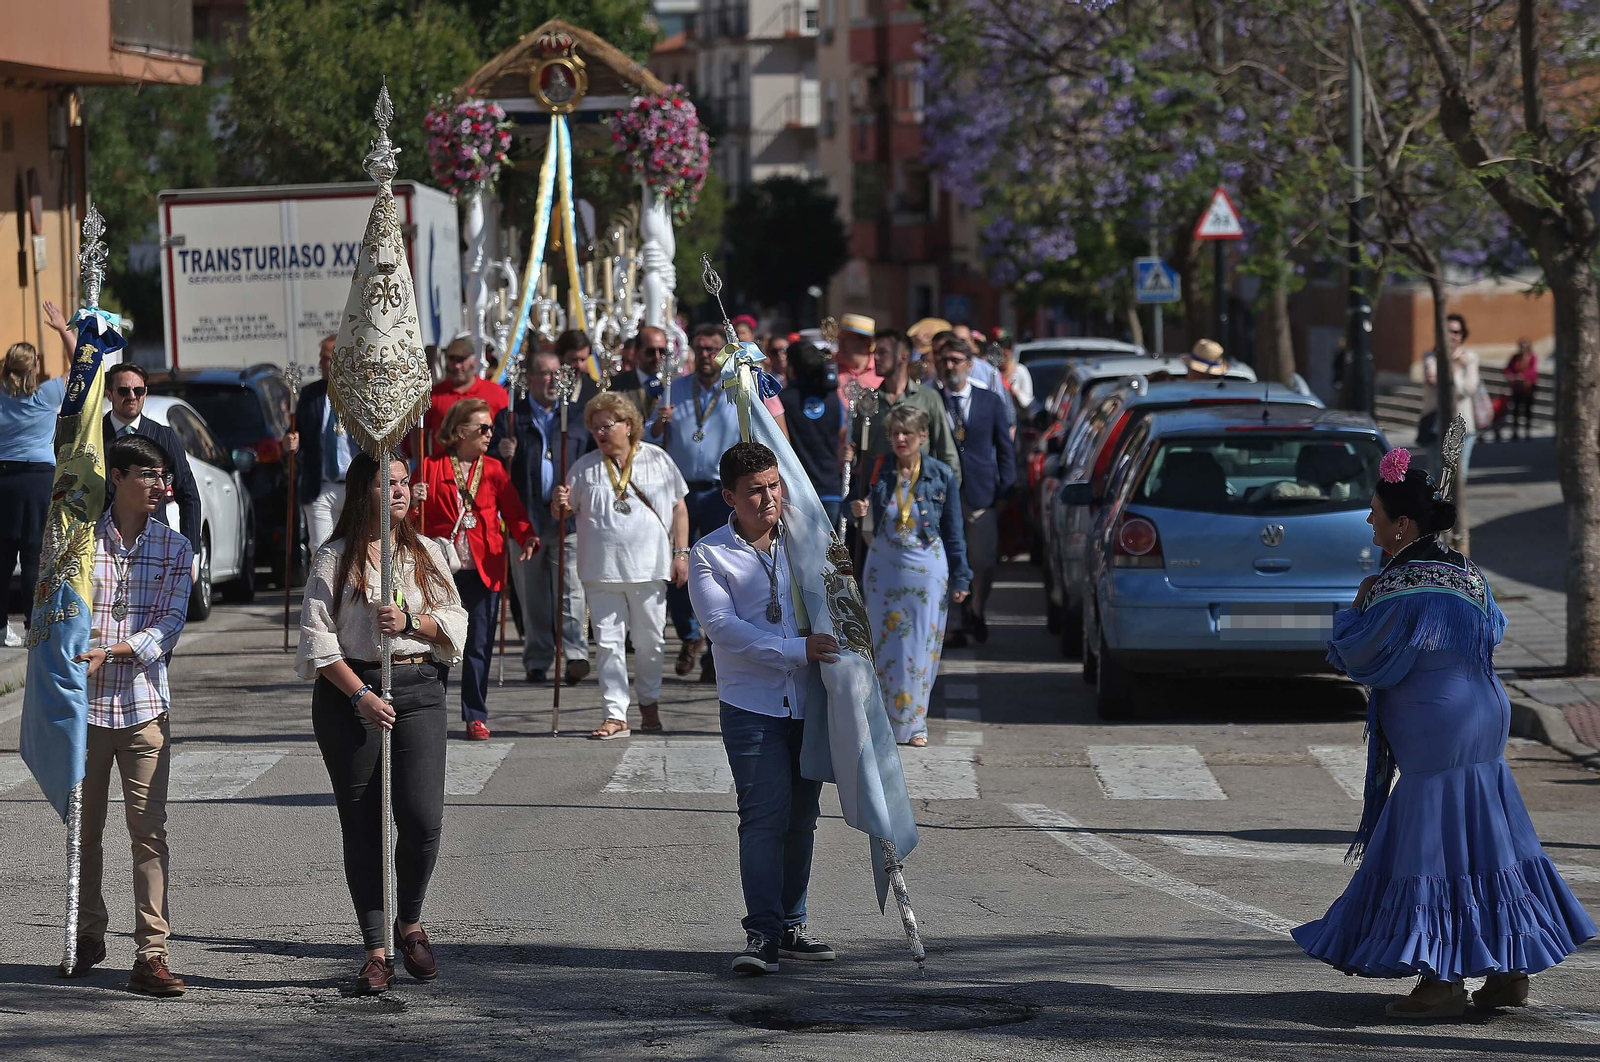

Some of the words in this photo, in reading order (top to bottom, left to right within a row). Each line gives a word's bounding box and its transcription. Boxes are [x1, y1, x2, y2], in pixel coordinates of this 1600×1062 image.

[178, 245, 326, 273] TRANSTURIASO
[188, 274, 242, 285] SERVICIOS
[245, 270, 300, 283] URGENTES
[303, 269, 323, 280] DEL
[349, 315, 416, 358] ALGECIRAS
